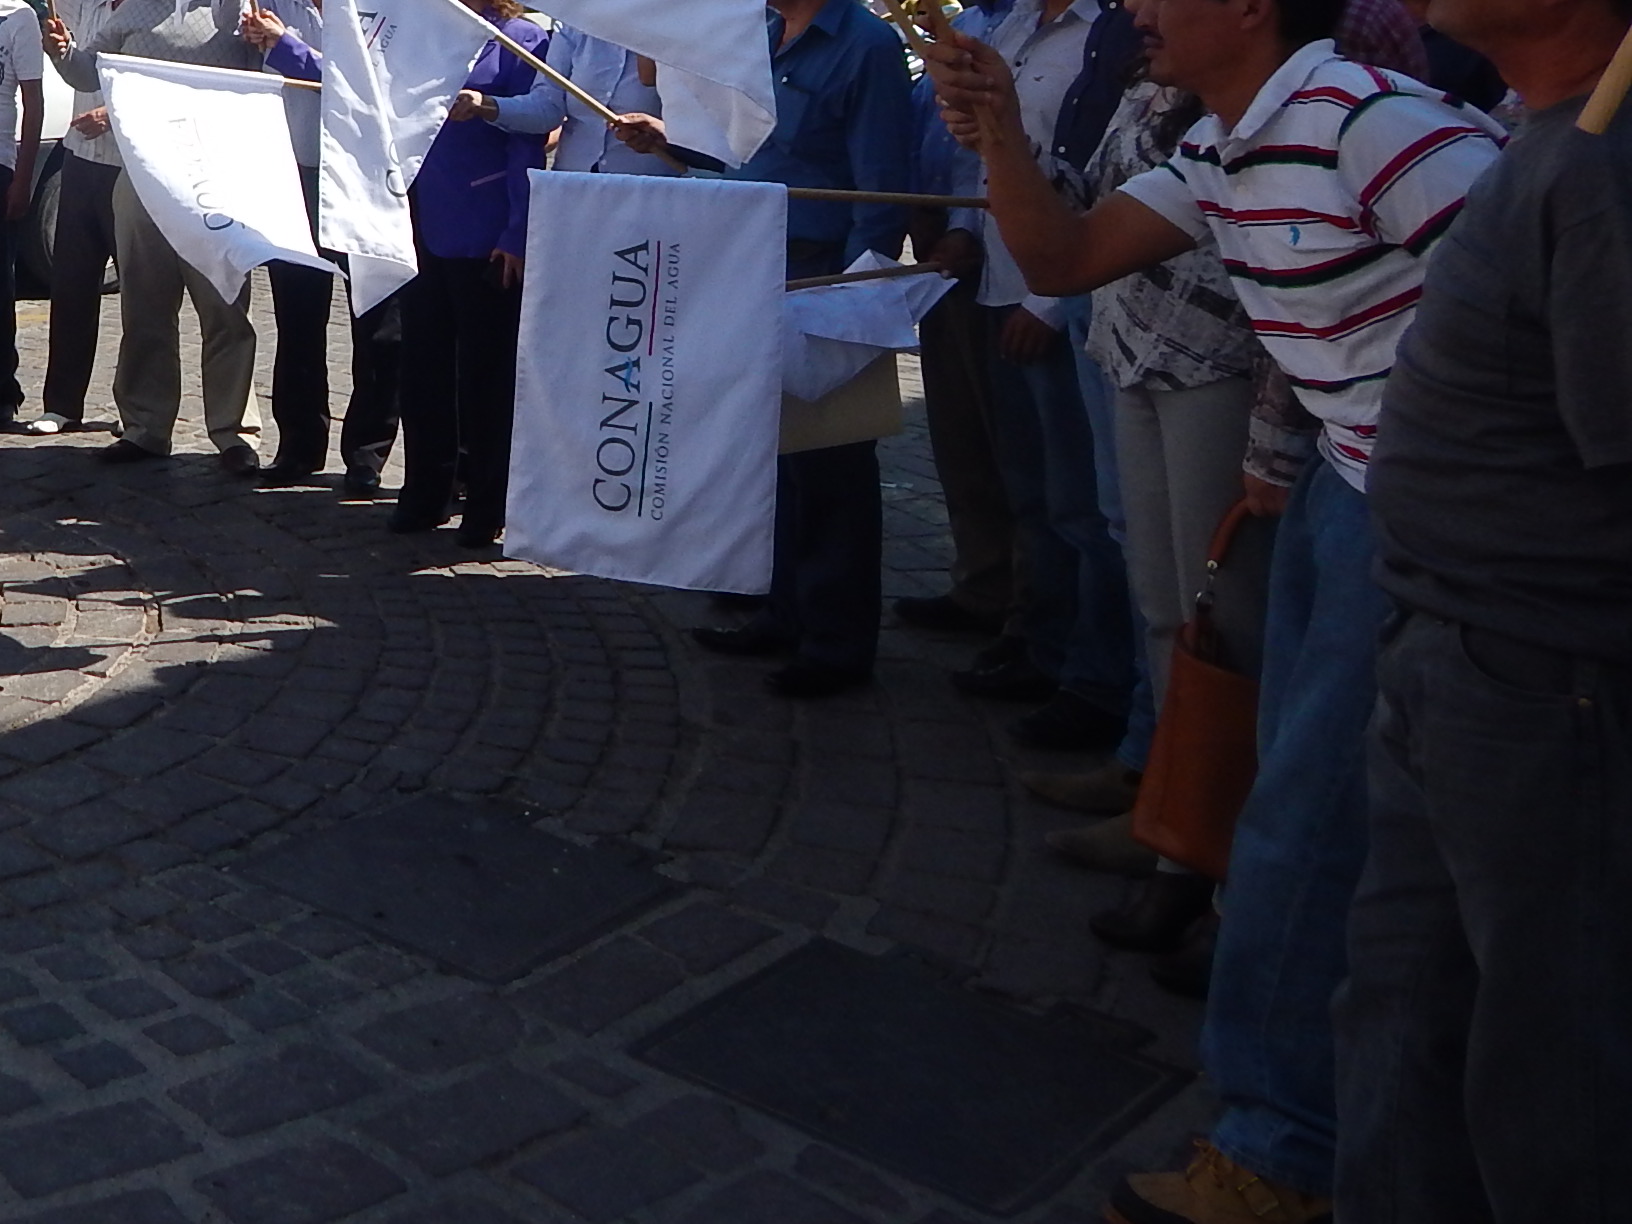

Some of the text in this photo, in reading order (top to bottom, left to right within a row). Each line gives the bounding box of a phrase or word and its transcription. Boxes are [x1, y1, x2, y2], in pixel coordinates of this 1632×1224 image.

[592, 239, 650, 512] CONAGUA
[651, 243, 680, 521] COMISIÓN NACIONAL DEL AGUA
